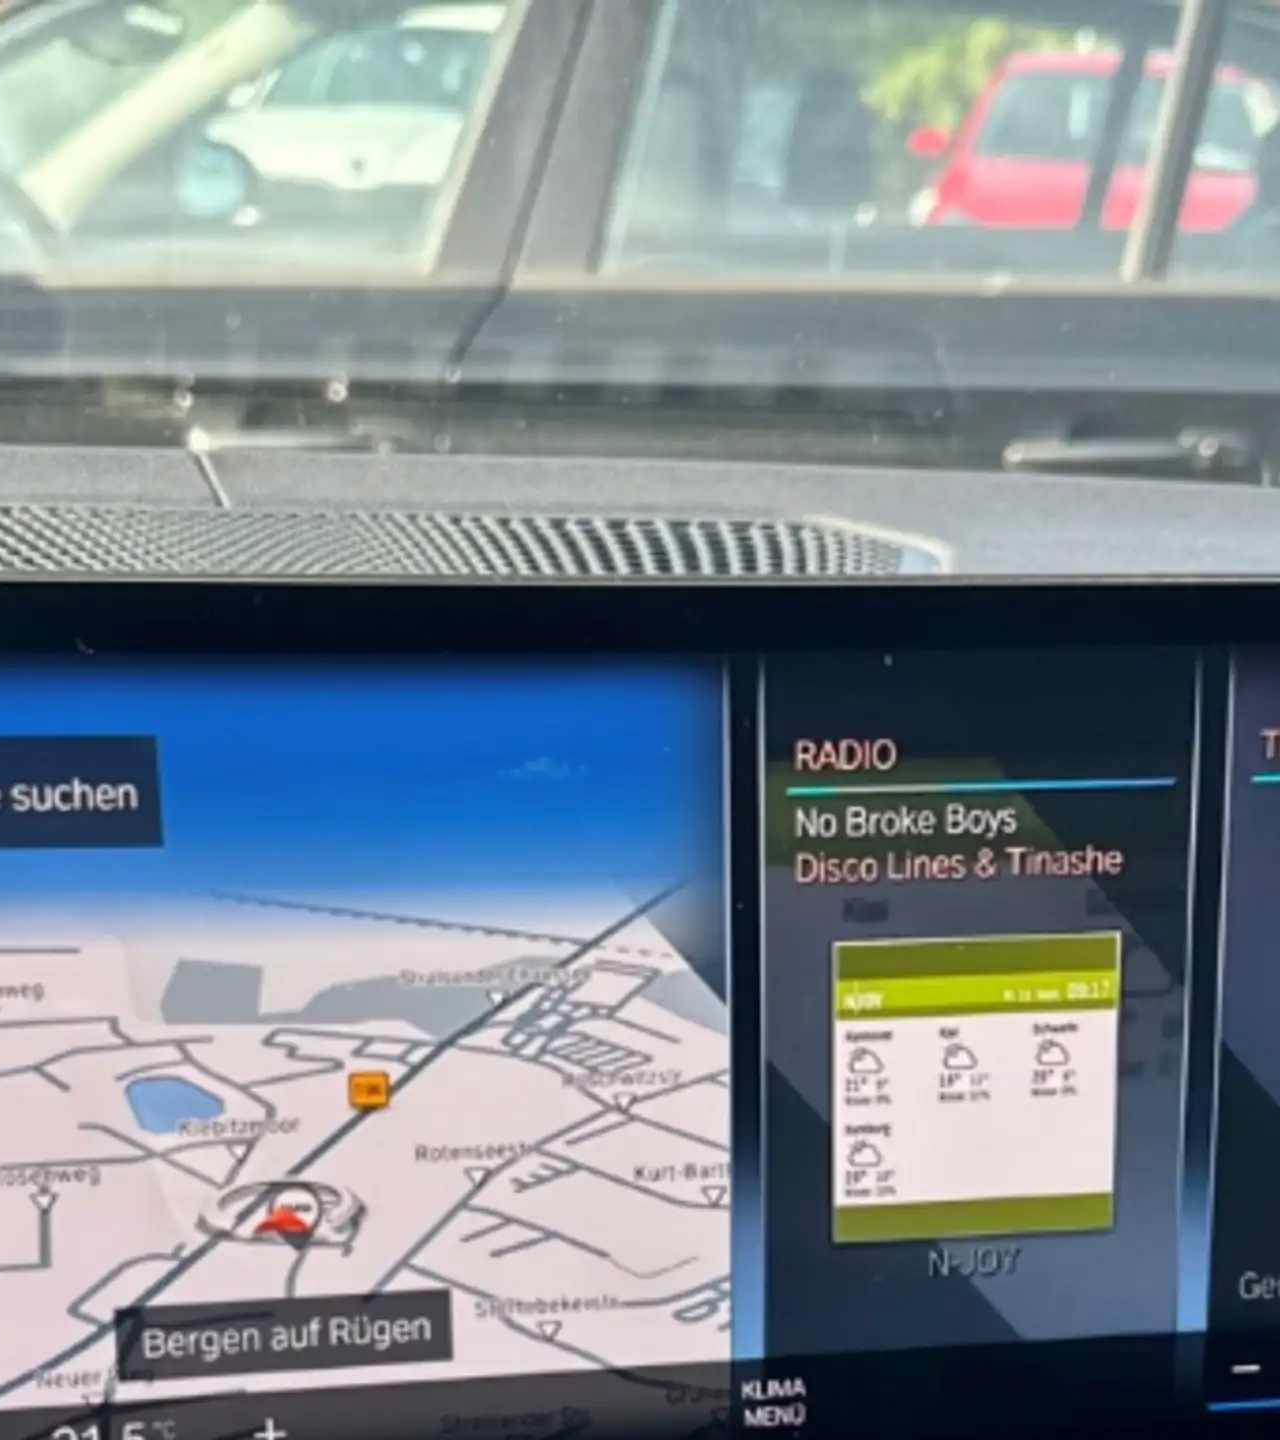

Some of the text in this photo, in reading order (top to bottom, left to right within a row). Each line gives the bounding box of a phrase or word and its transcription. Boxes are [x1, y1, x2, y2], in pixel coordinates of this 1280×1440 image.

[794, 738, 898, 771] RADIO
[9, 776, 139, 811] suchen
[794, 802, 1019, 839] No Broke Boys
[794, 844, 1124, 883] Disco Lines & Tinashe
[928, 1246, 1023, 1277] N-JOY
[143, 1313, 432, 1362] Bergen auf Rügen
[741, 1376, 807, 1401] KLIMA
[744, 1402, 807, 1430] MENÜ
